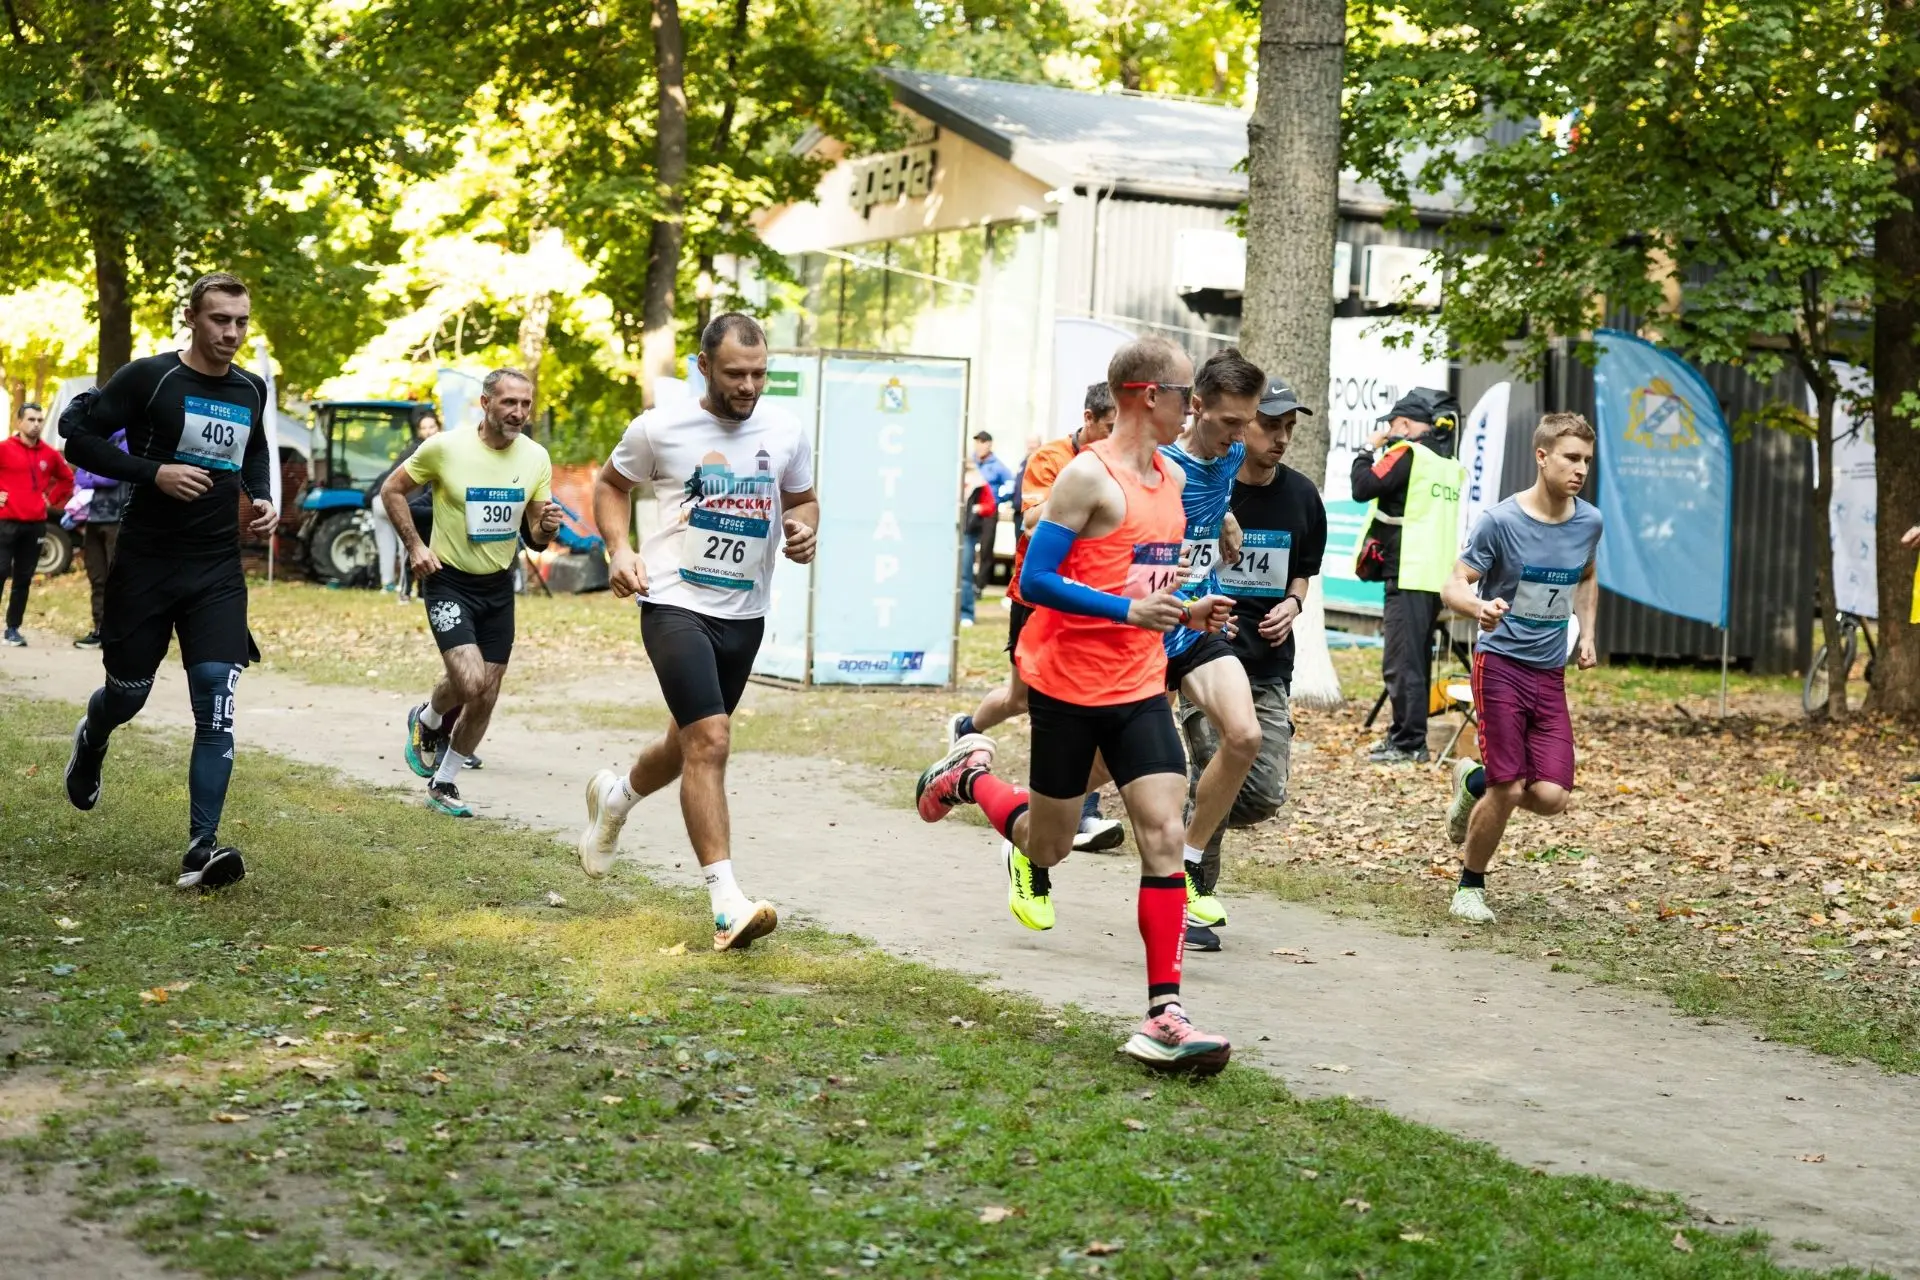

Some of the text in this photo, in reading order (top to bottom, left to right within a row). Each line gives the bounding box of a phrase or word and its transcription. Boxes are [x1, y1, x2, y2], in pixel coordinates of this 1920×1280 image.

[1334, 377, 1378, 411] РОСС
[201, 421, 235, 447] 403
[483, 505, 512, 523] 390
[705, 496, 772, 511] КУРСКИЙ
[719, 517, 746, 528] КРОСС
[873, 423, 906, 628] СТАРТ
[703, 535, 746, 564] 276
[1231, 550, 1270, 574] 214
[1547, 588, 1560, 608] 7
[838, 659, 889, 673] арена
